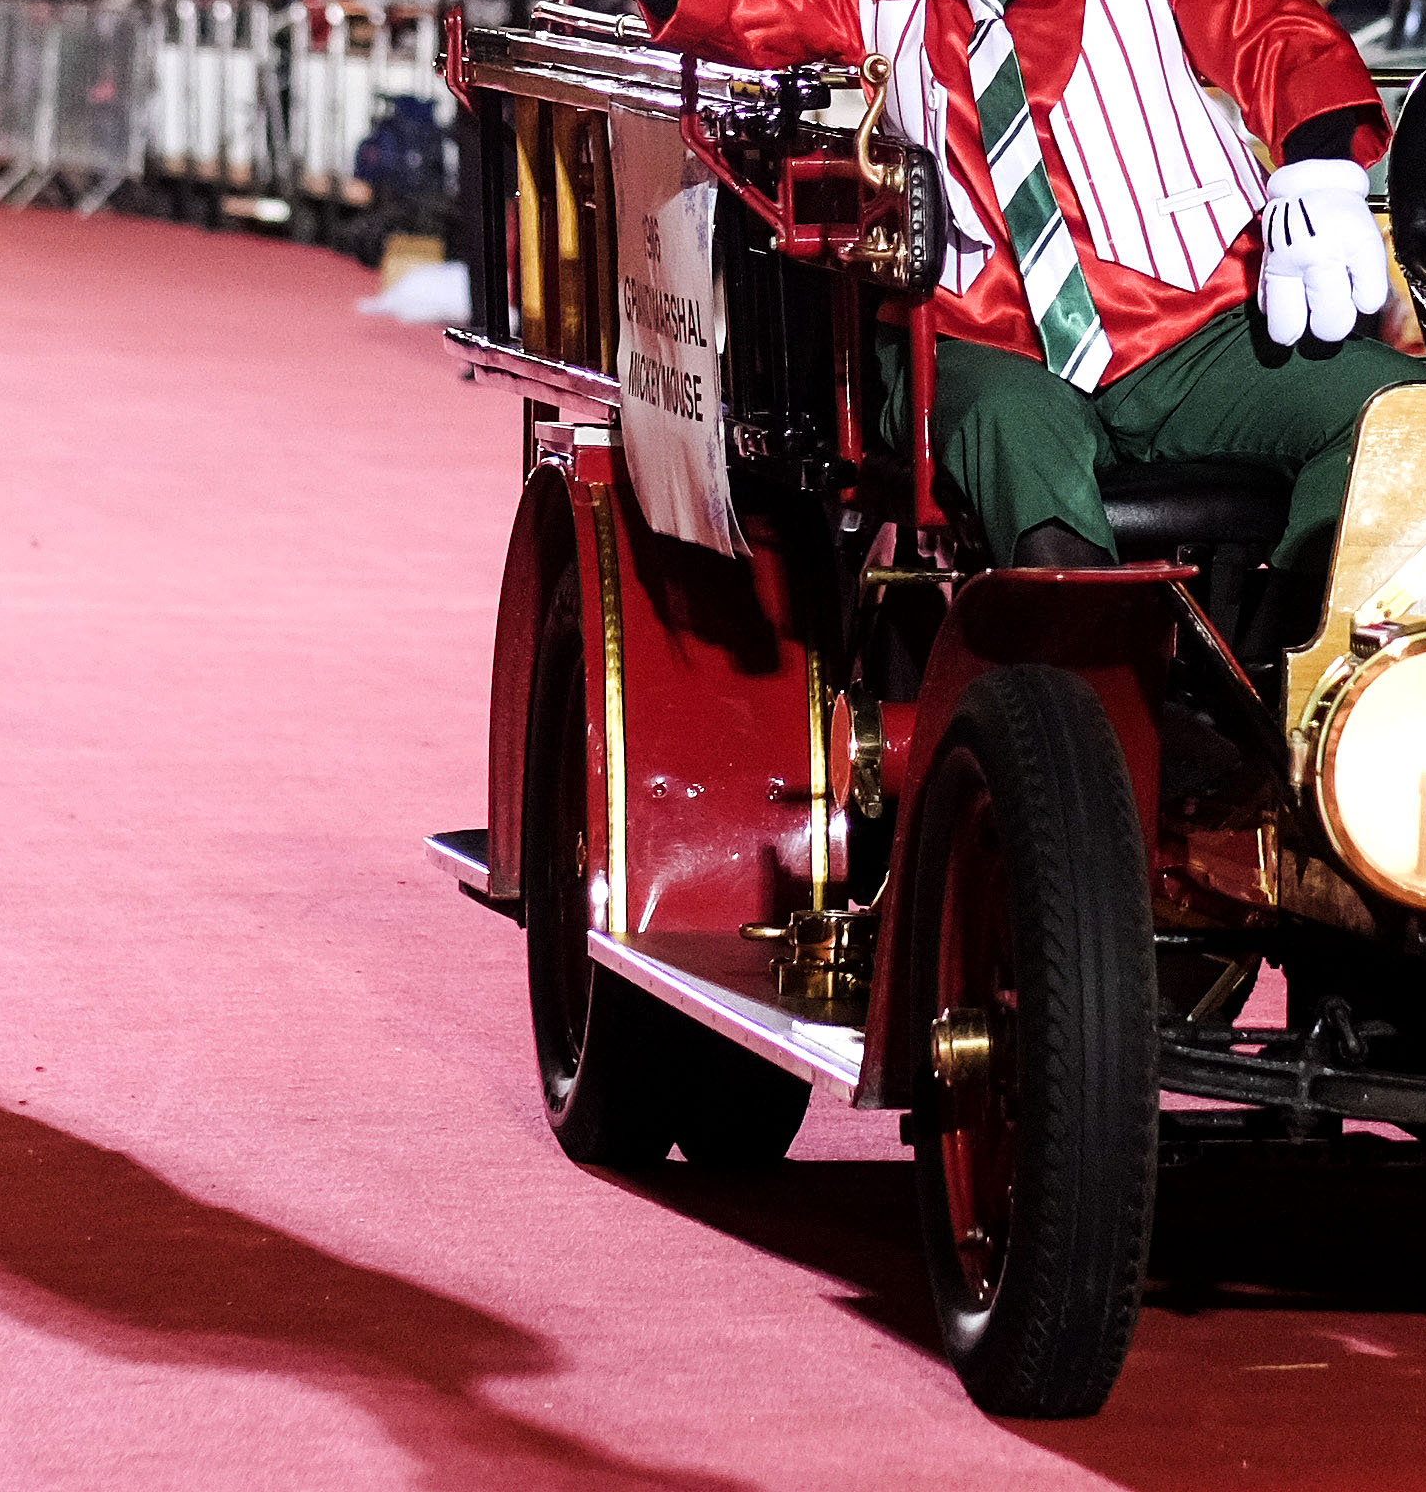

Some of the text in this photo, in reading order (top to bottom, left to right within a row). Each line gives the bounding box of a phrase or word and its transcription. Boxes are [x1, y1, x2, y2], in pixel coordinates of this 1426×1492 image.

[652, 285, 707, 348] MARSHAL
[628, 350, 705, 423] MICKEY MOUSE
